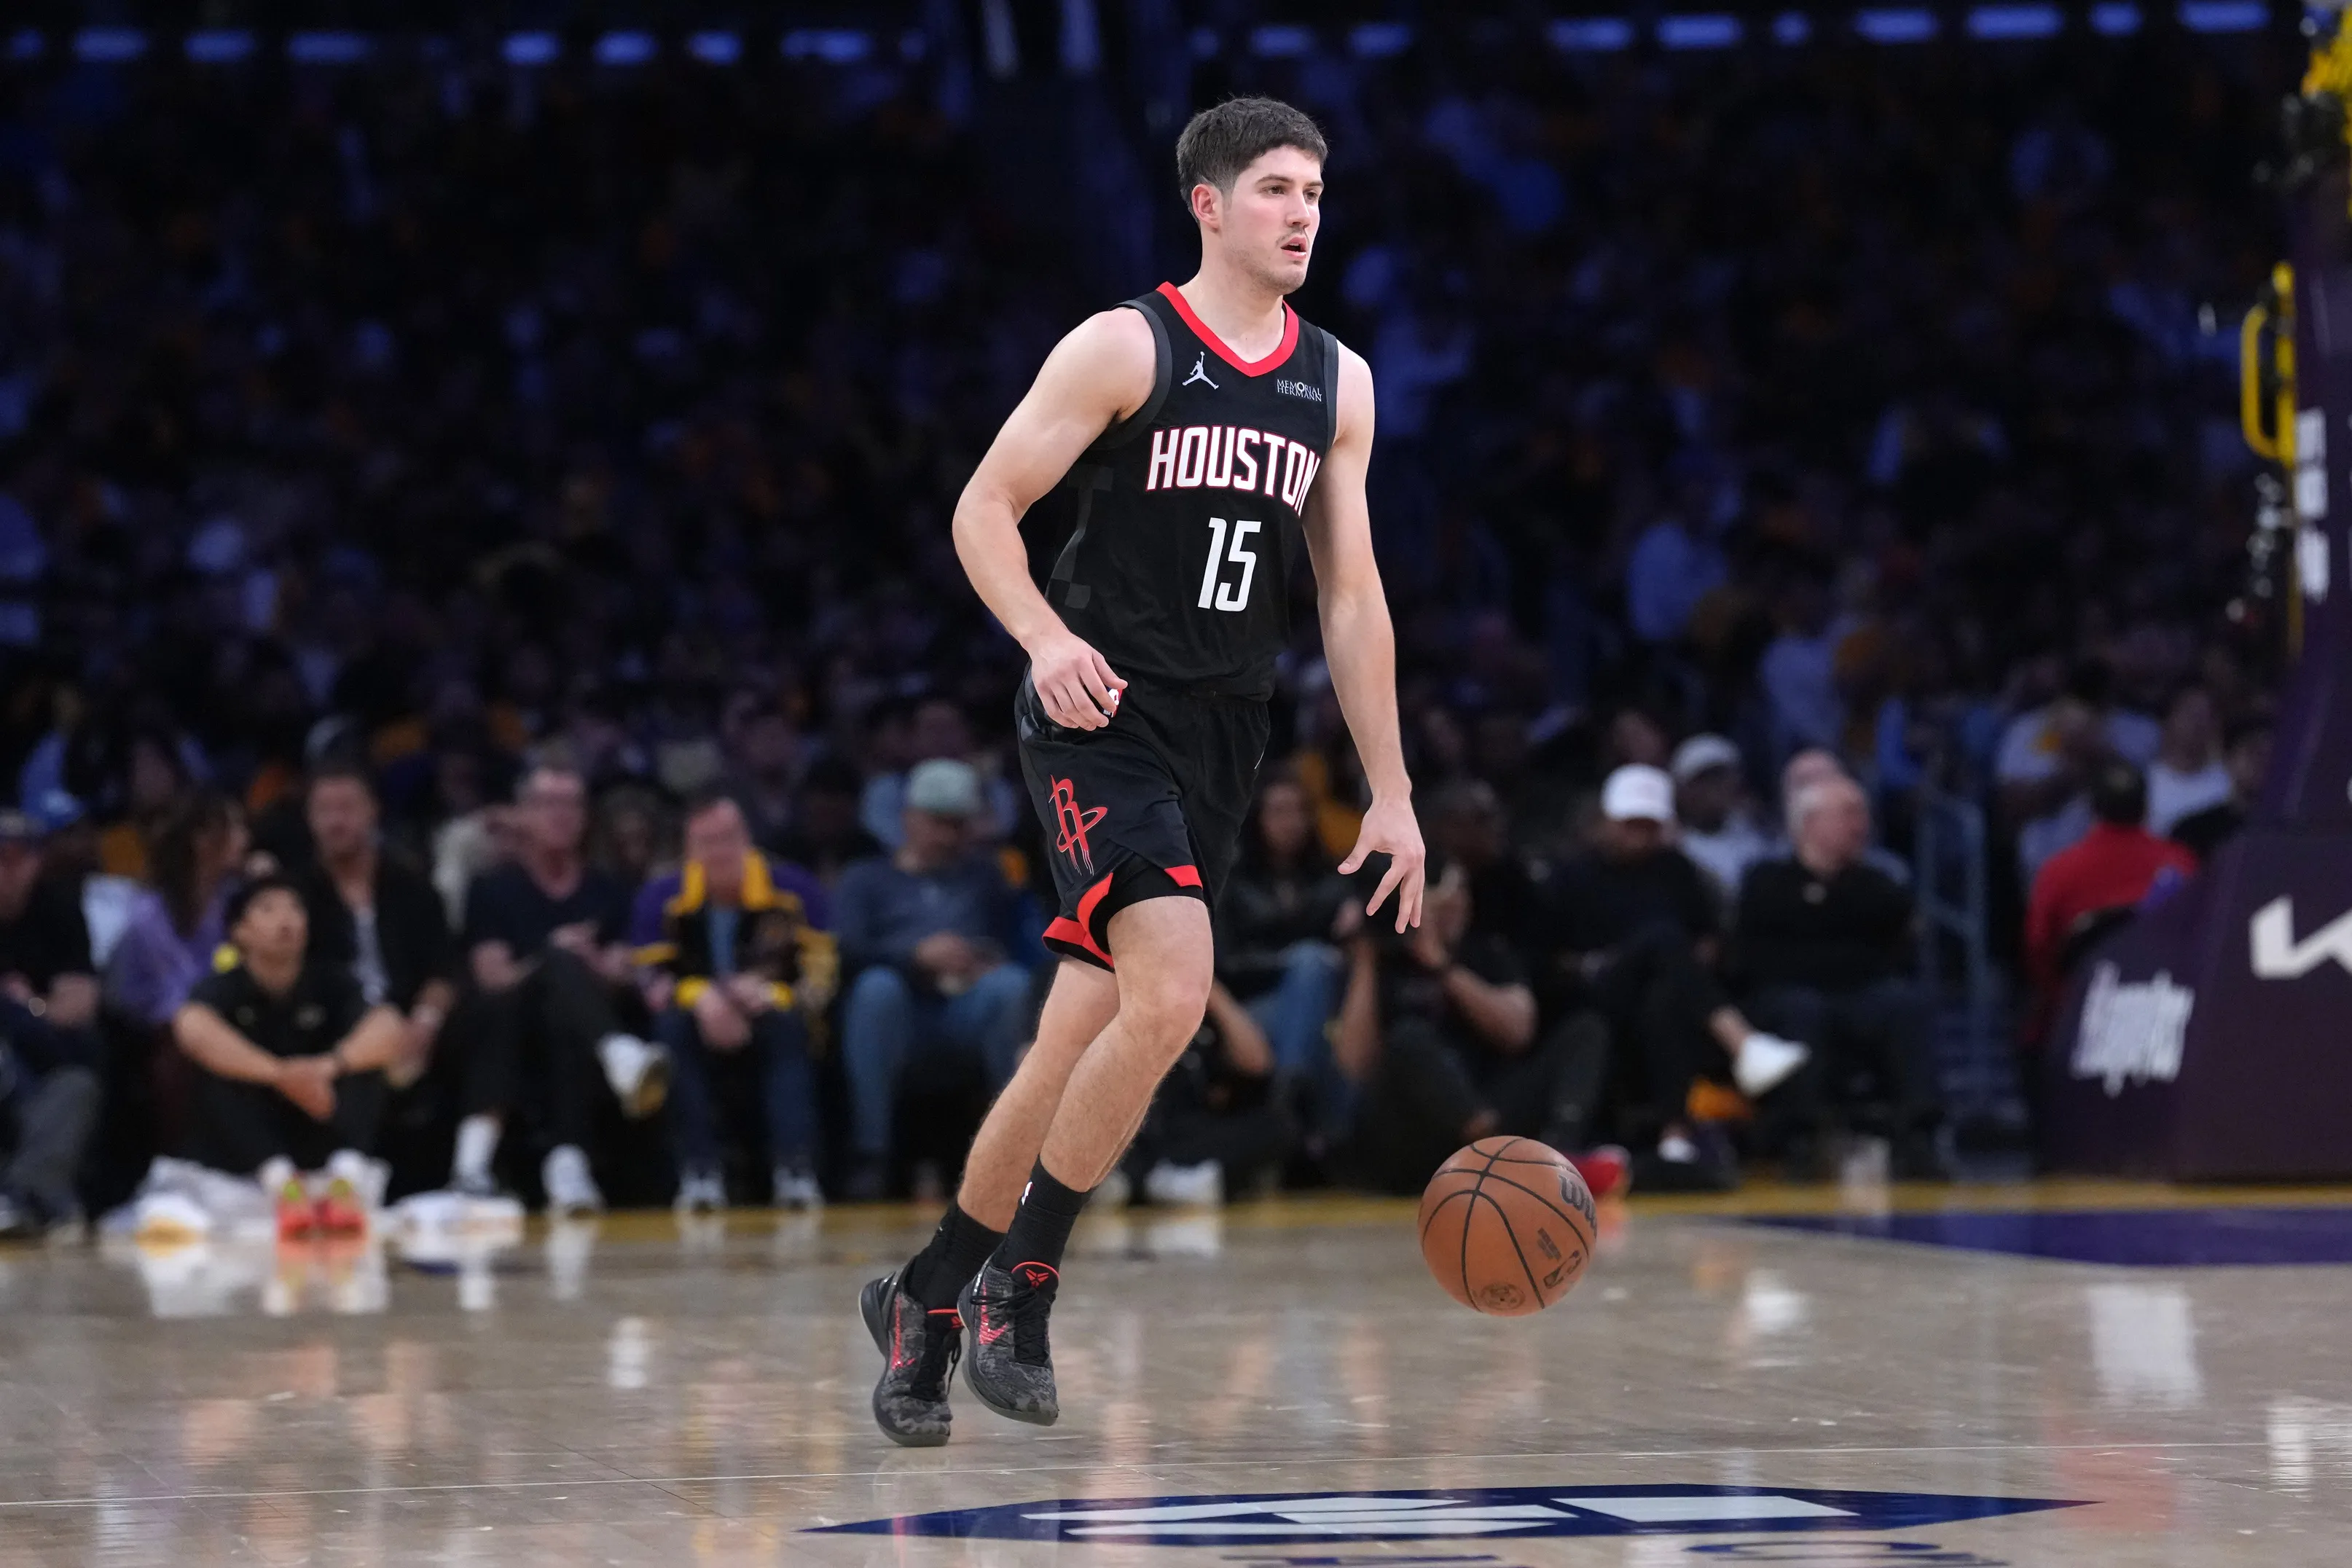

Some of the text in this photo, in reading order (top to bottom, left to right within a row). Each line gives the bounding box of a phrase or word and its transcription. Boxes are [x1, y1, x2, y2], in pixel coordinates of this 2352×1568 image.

[1277, 379, 1322, 396] MEMORIAL
[1277, 385, 1322, 402] HERMANN
[1145, 425, 1321, 519] HOUSTON
[1198, 517, 1262, 612] 15
